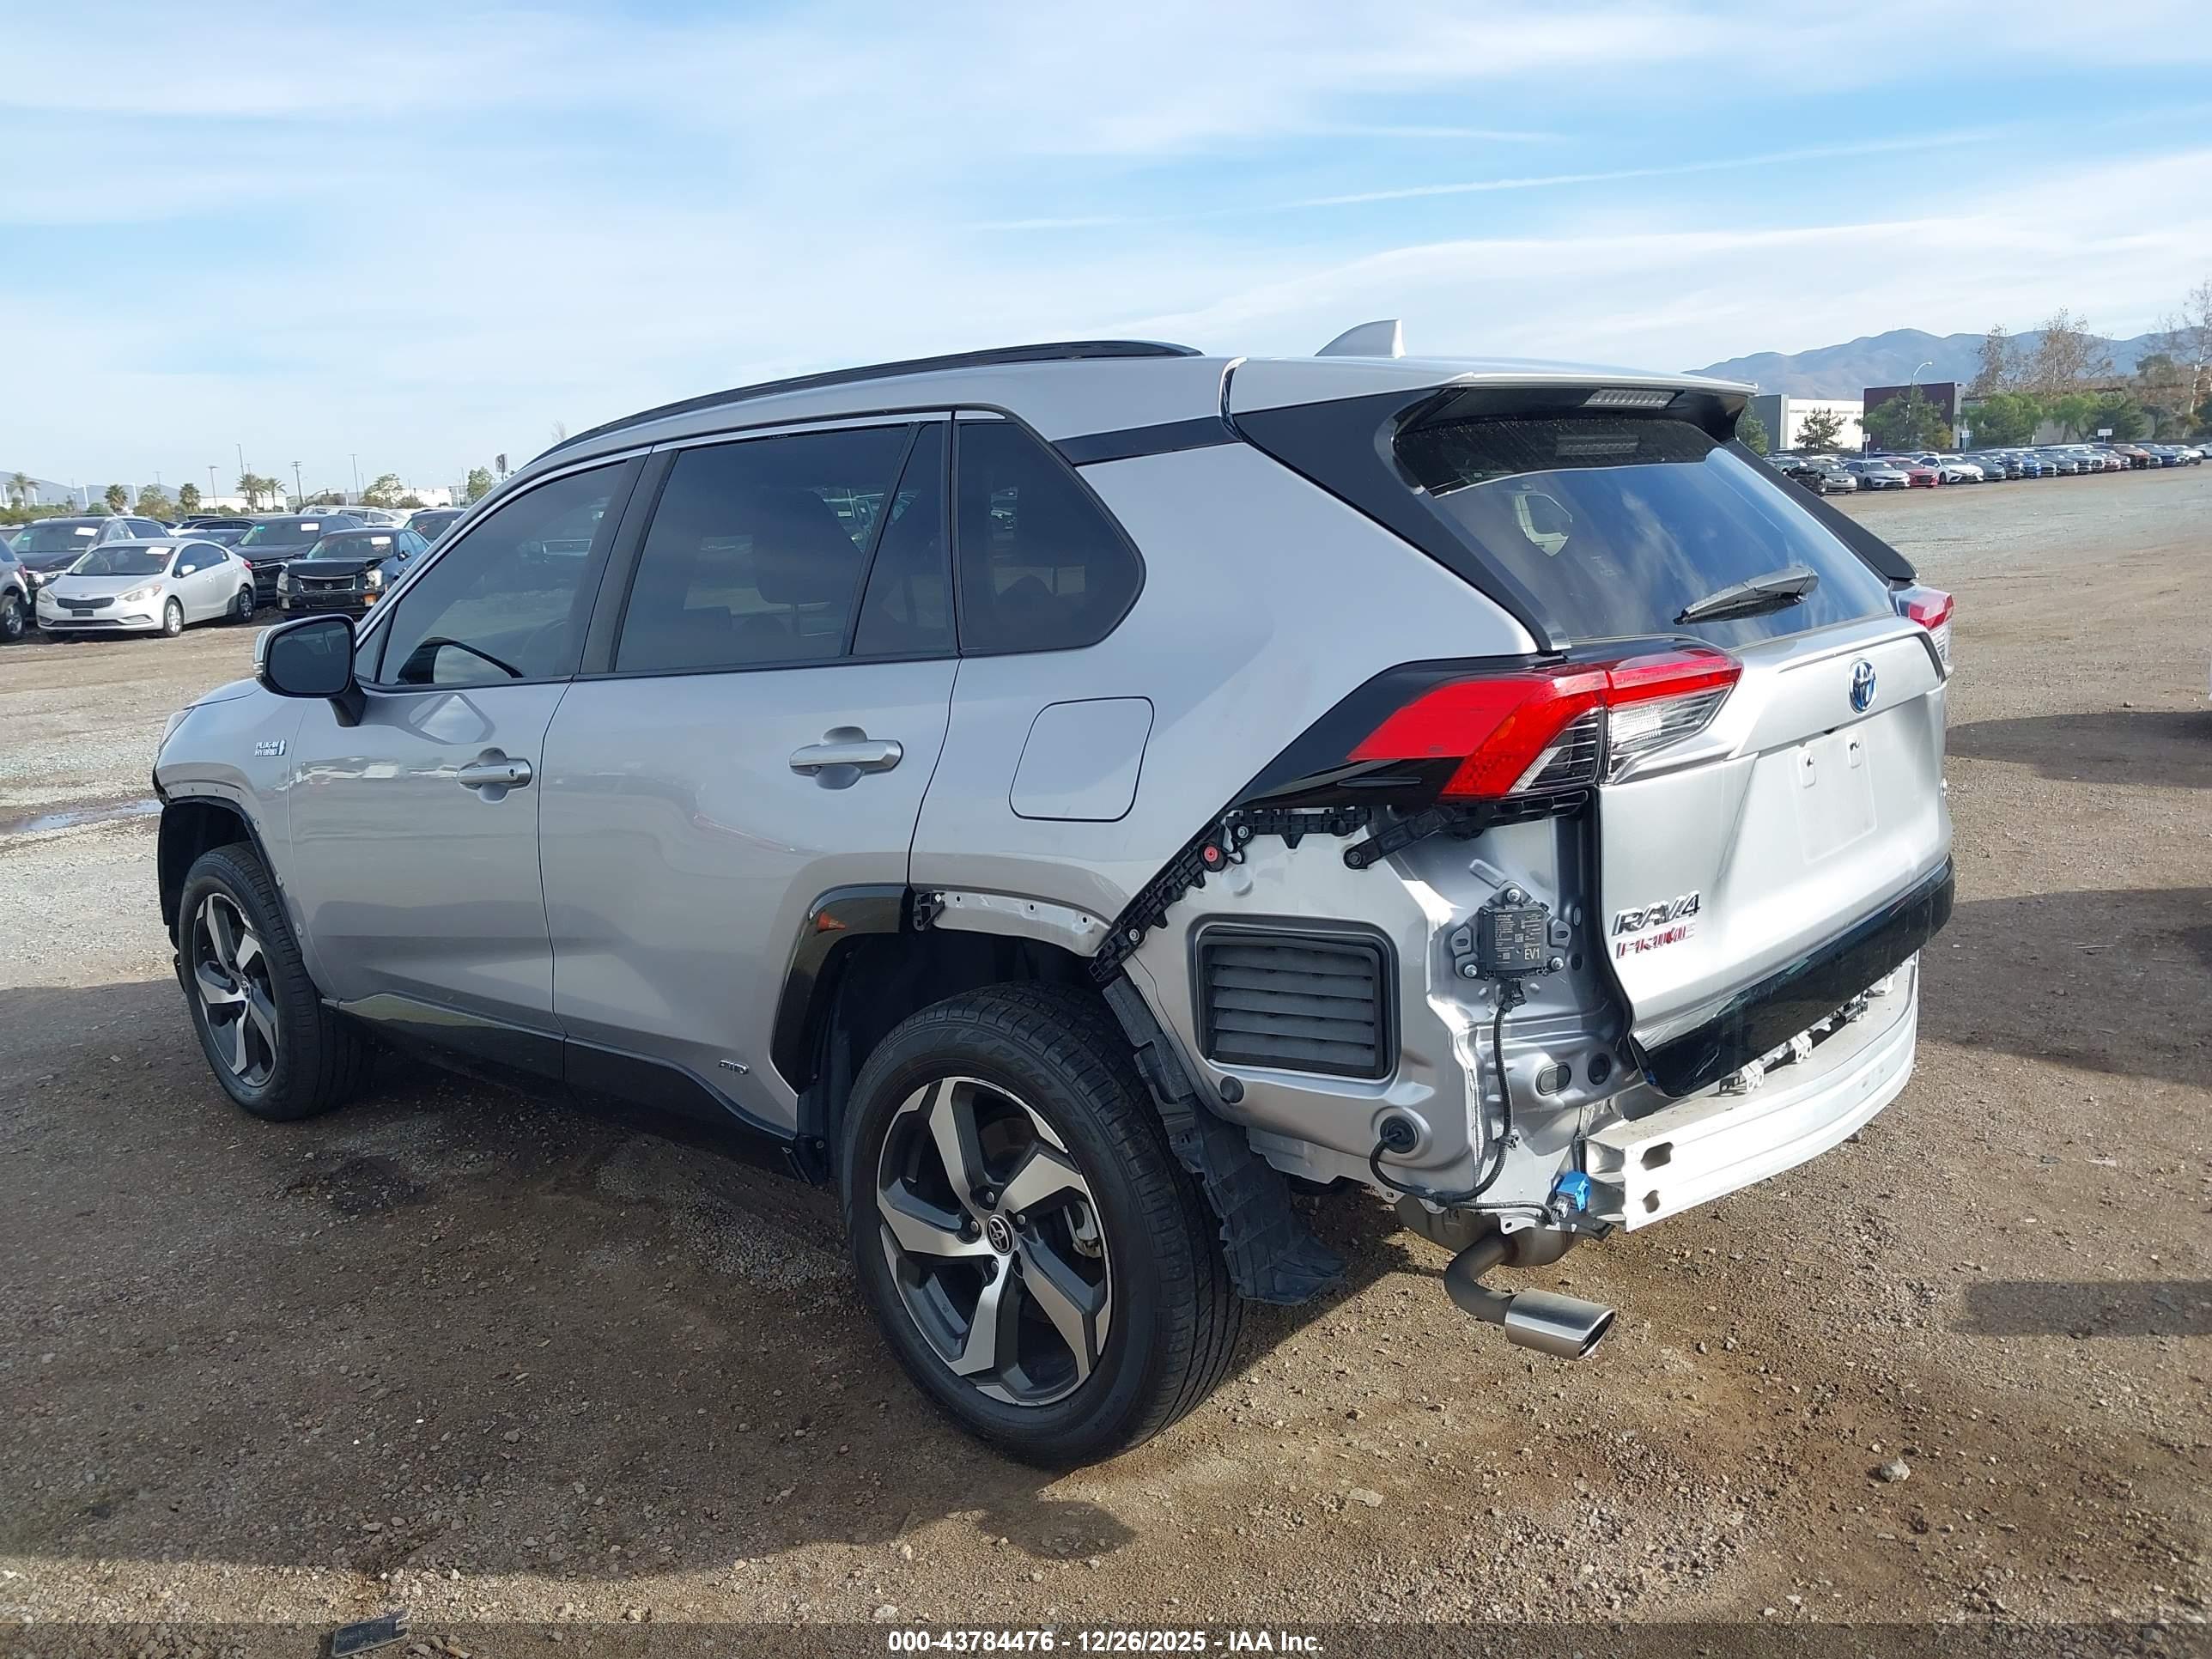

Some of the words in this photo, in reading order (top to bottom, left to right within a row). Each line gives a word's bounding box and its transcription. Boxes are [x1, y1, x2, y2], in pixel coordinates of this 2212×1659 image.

[1612, 890, 1701, 936] RAV4
[1524, 947, 1540, 960] EV1
[1616, 922, 1696, 959] PRIME
